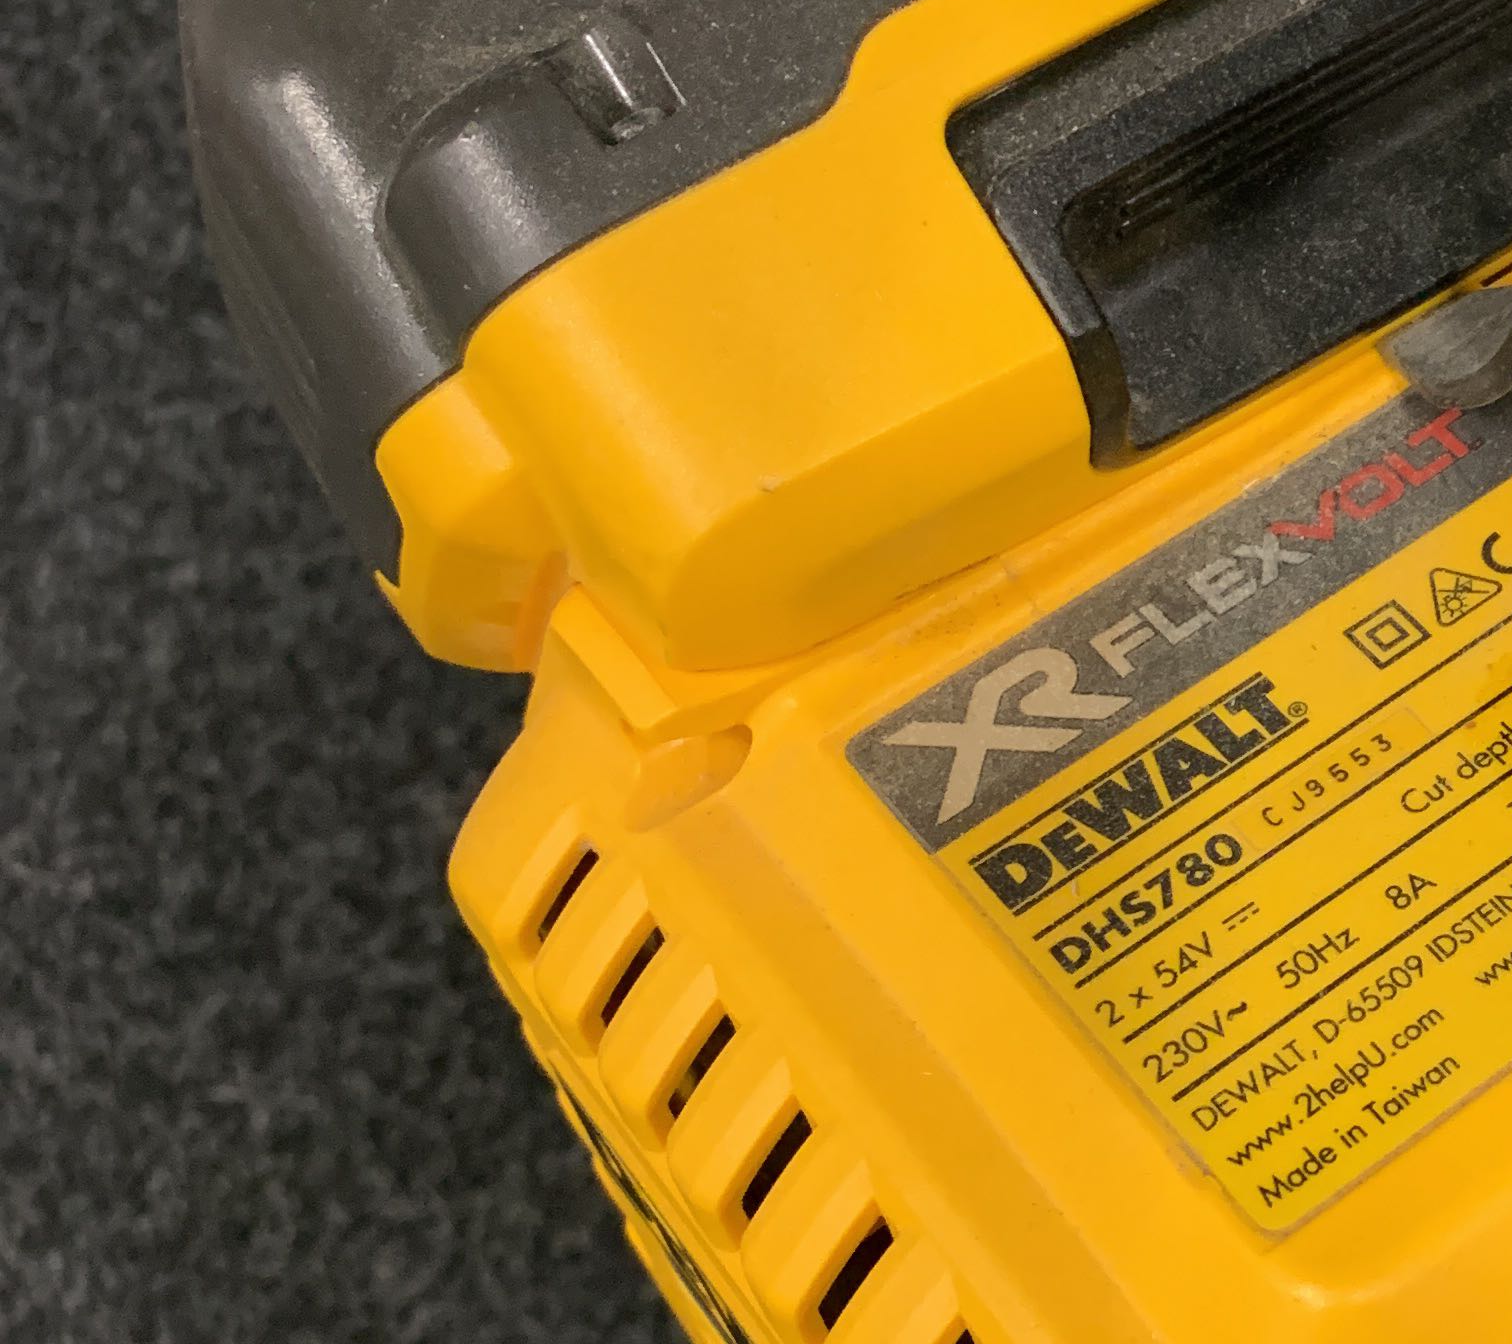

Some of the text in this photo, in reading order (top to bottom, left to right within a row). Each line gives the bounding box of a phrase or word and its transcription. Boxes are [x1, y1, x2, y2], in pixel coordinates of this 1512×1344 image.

[880, 407, 1469, 825] XR FLEXVOLT
[1401, 775, 1453, 814] Cut
[1048, 833, 1243, 975] DHS780
[1277, 927, 1361, 989] 50Hz
[1384, 872, 1437, 911] 8A
[1095, 931, 1215, 1028] 2 x 54V
[1192, 1039, 1318, 1132] DEWALT,
[1312, 955, 1425, 1045] D-65509
[1226, 1006, 1445, 1167] www.2helpU.com
[1257, 1055, 1461, 1208] Made in Taiwan
